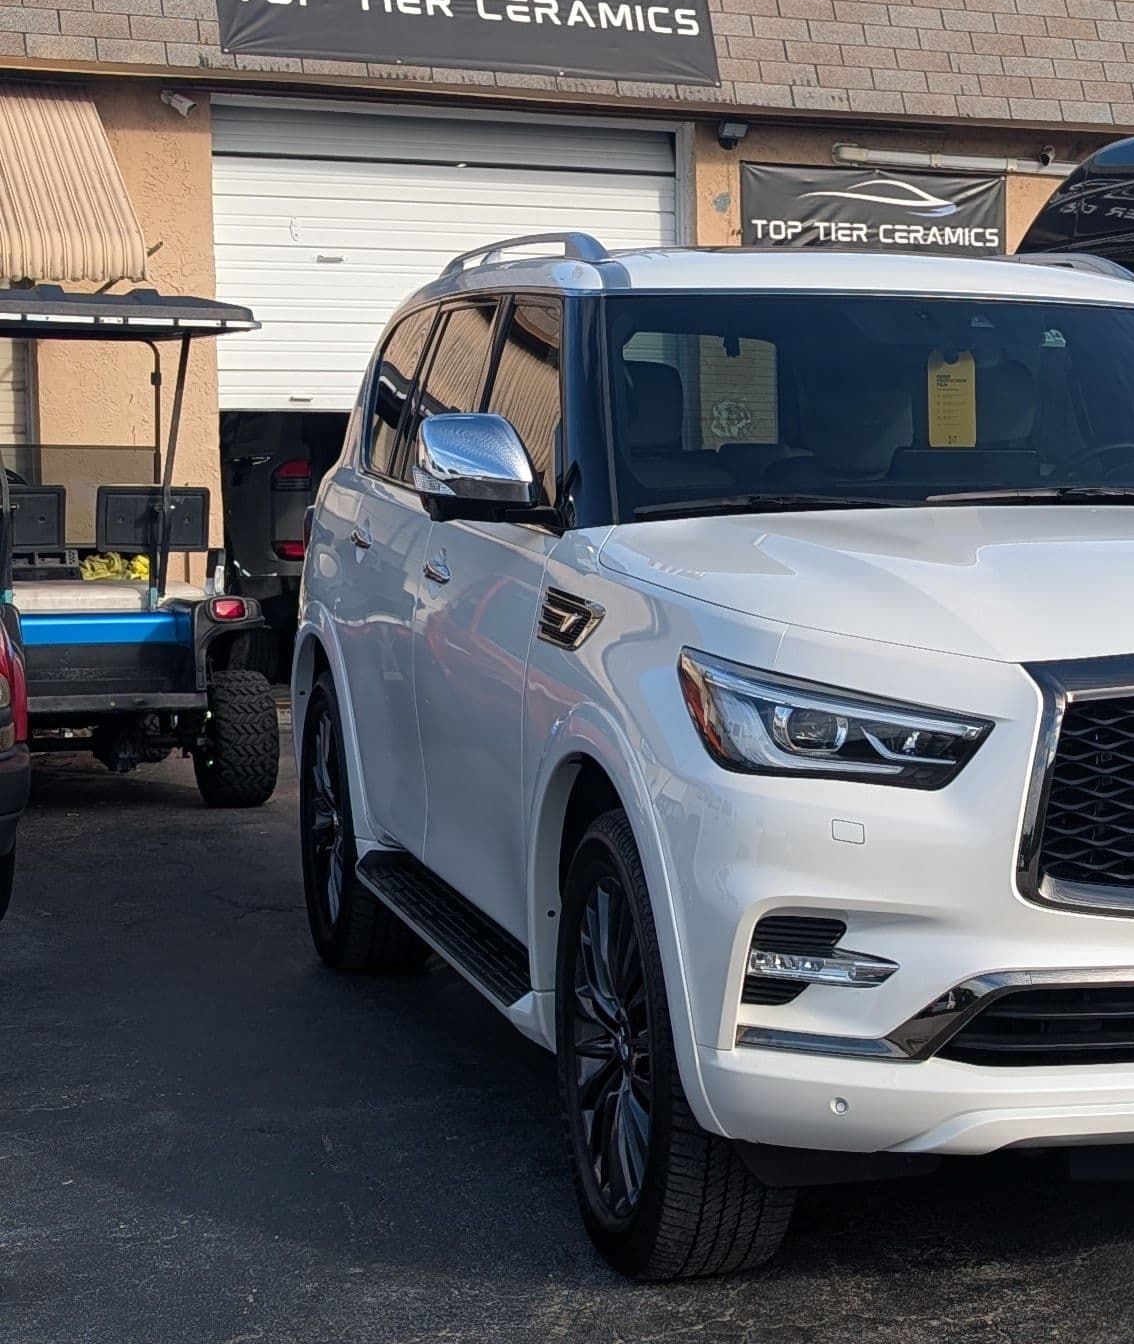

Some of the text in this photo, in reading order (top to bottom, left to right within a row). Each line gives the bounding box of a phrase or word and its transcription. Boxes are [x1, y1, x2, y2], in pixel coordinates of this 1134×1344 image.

[751, 219, 1000, 248] TOP TIER CERAMICS
